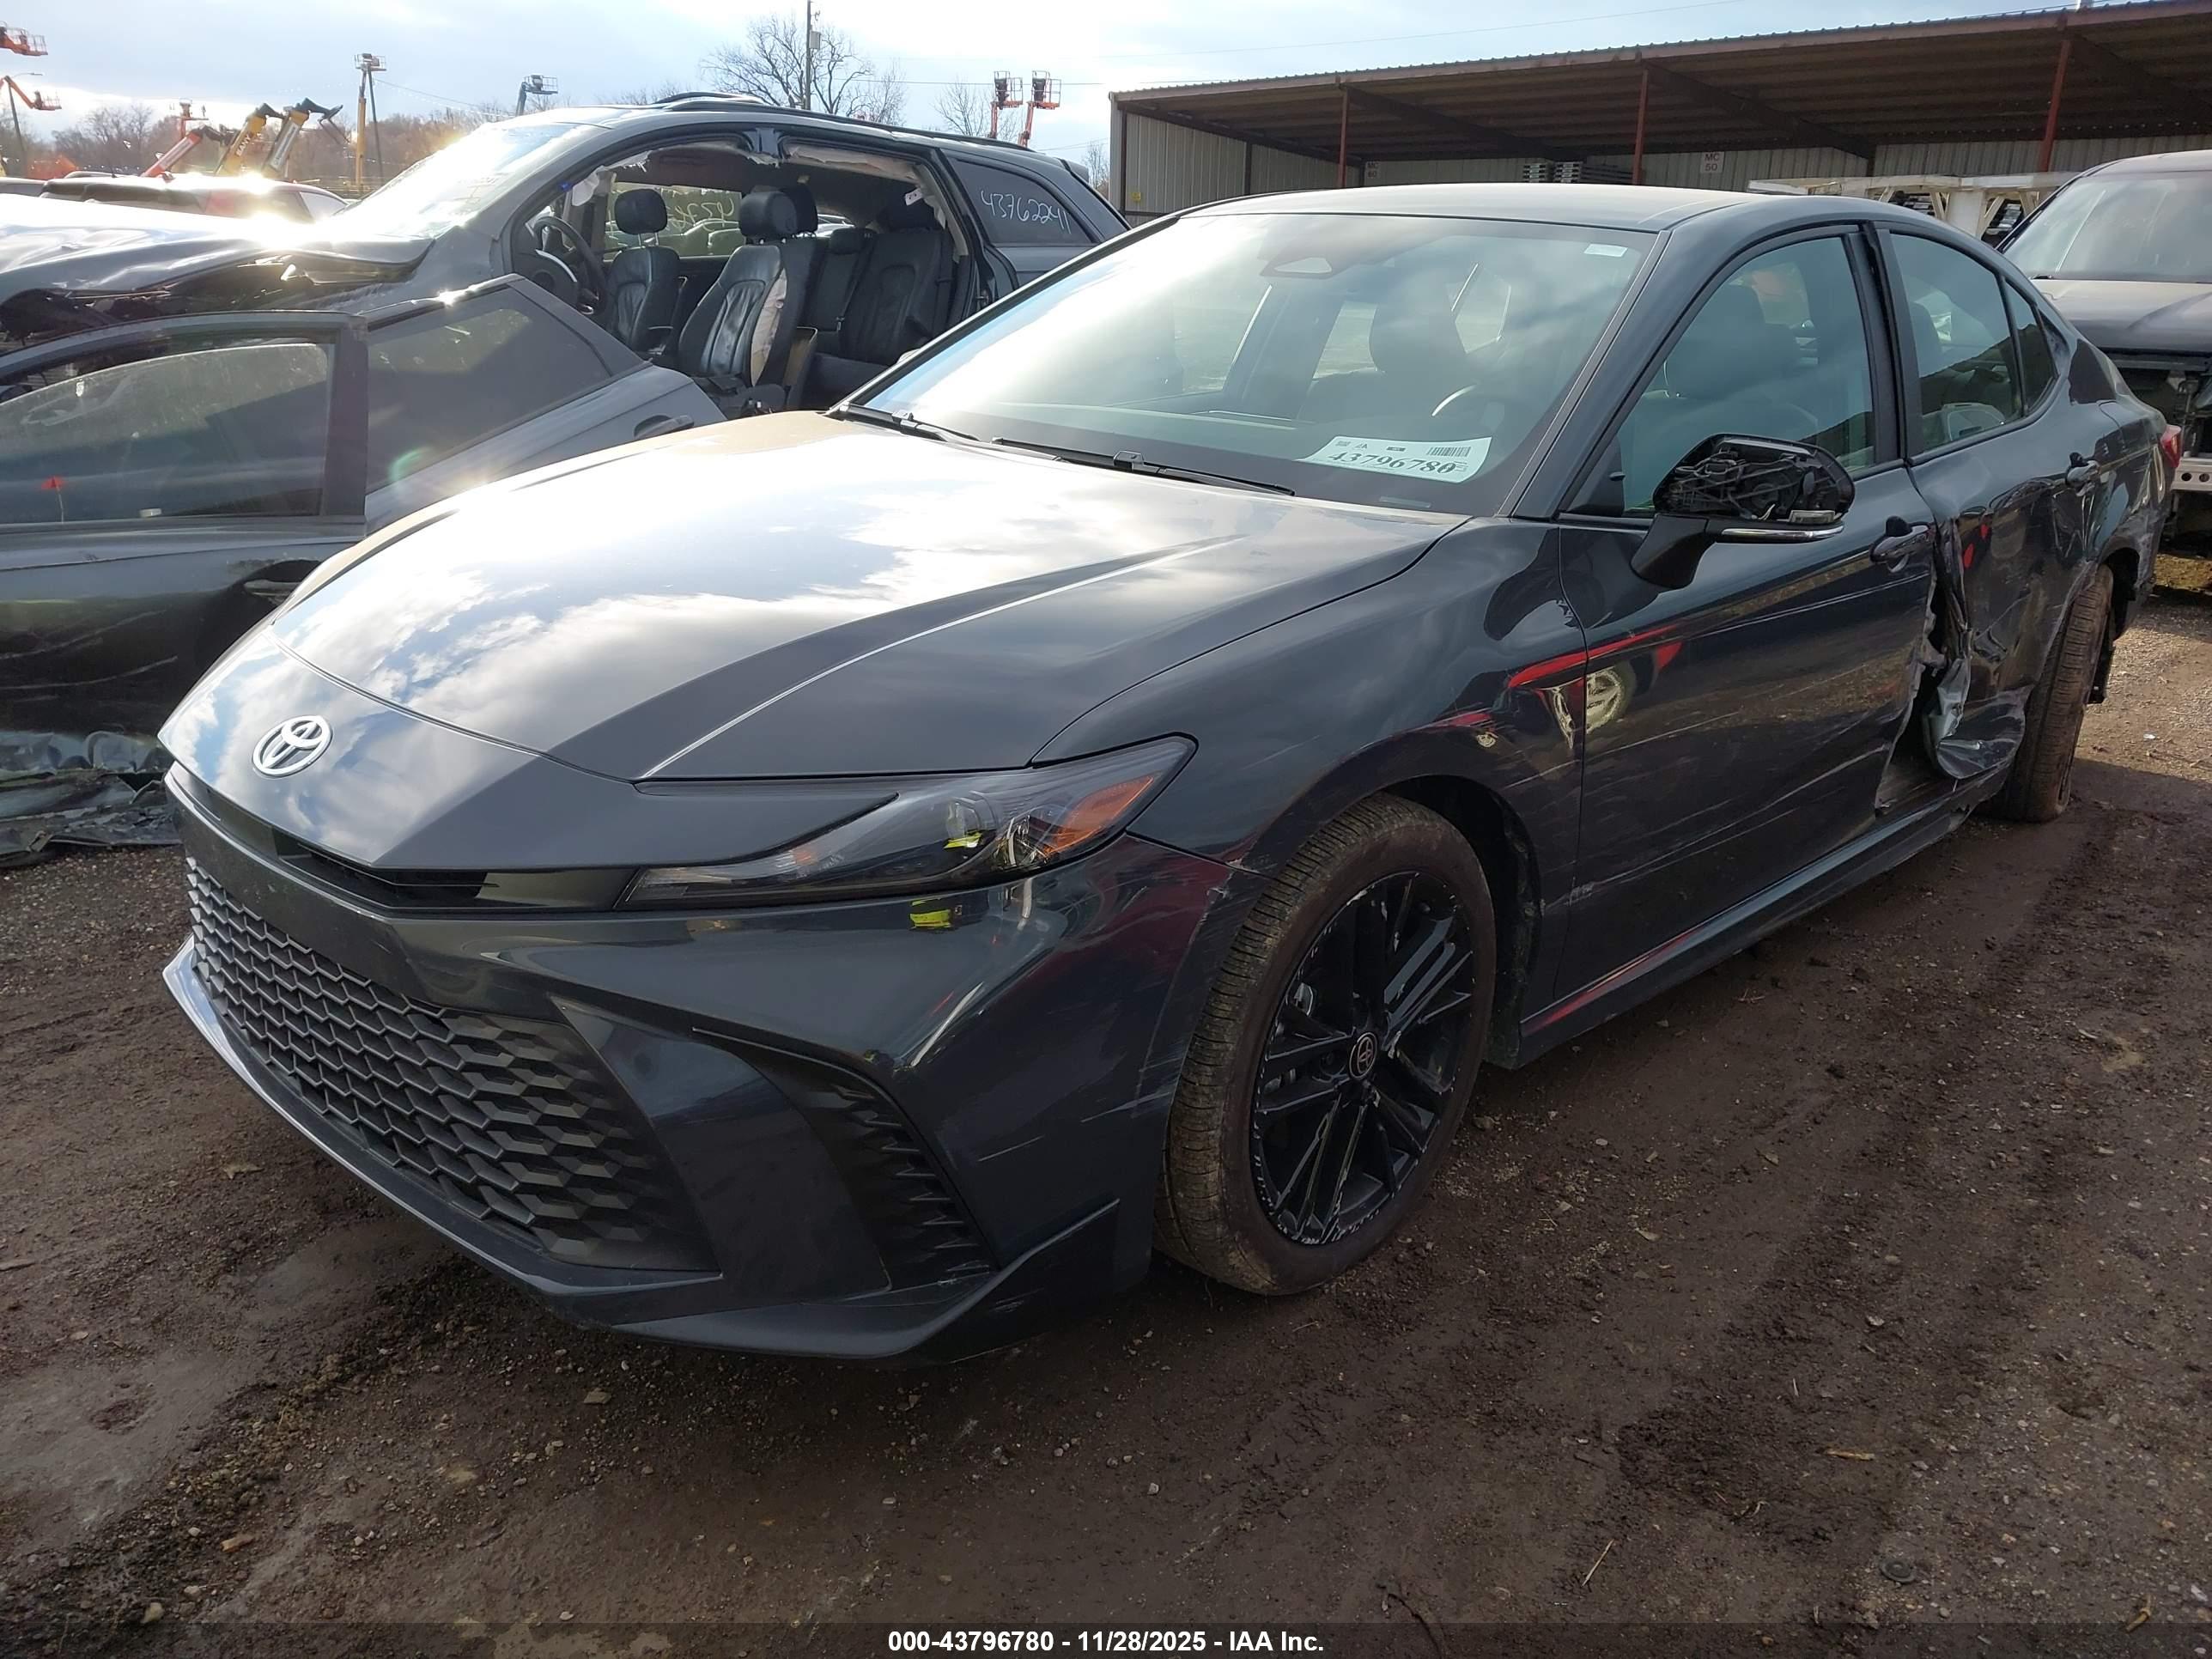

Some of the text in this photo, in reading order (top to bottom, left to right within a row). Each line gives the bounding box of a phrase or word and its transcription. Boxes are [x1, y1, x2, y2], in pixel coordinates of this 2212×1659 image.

[1705, 153, 1720, 161] MC
[1705, 163, 1718, 172] 50
[1328, 452, 1455, 474] 43796780
